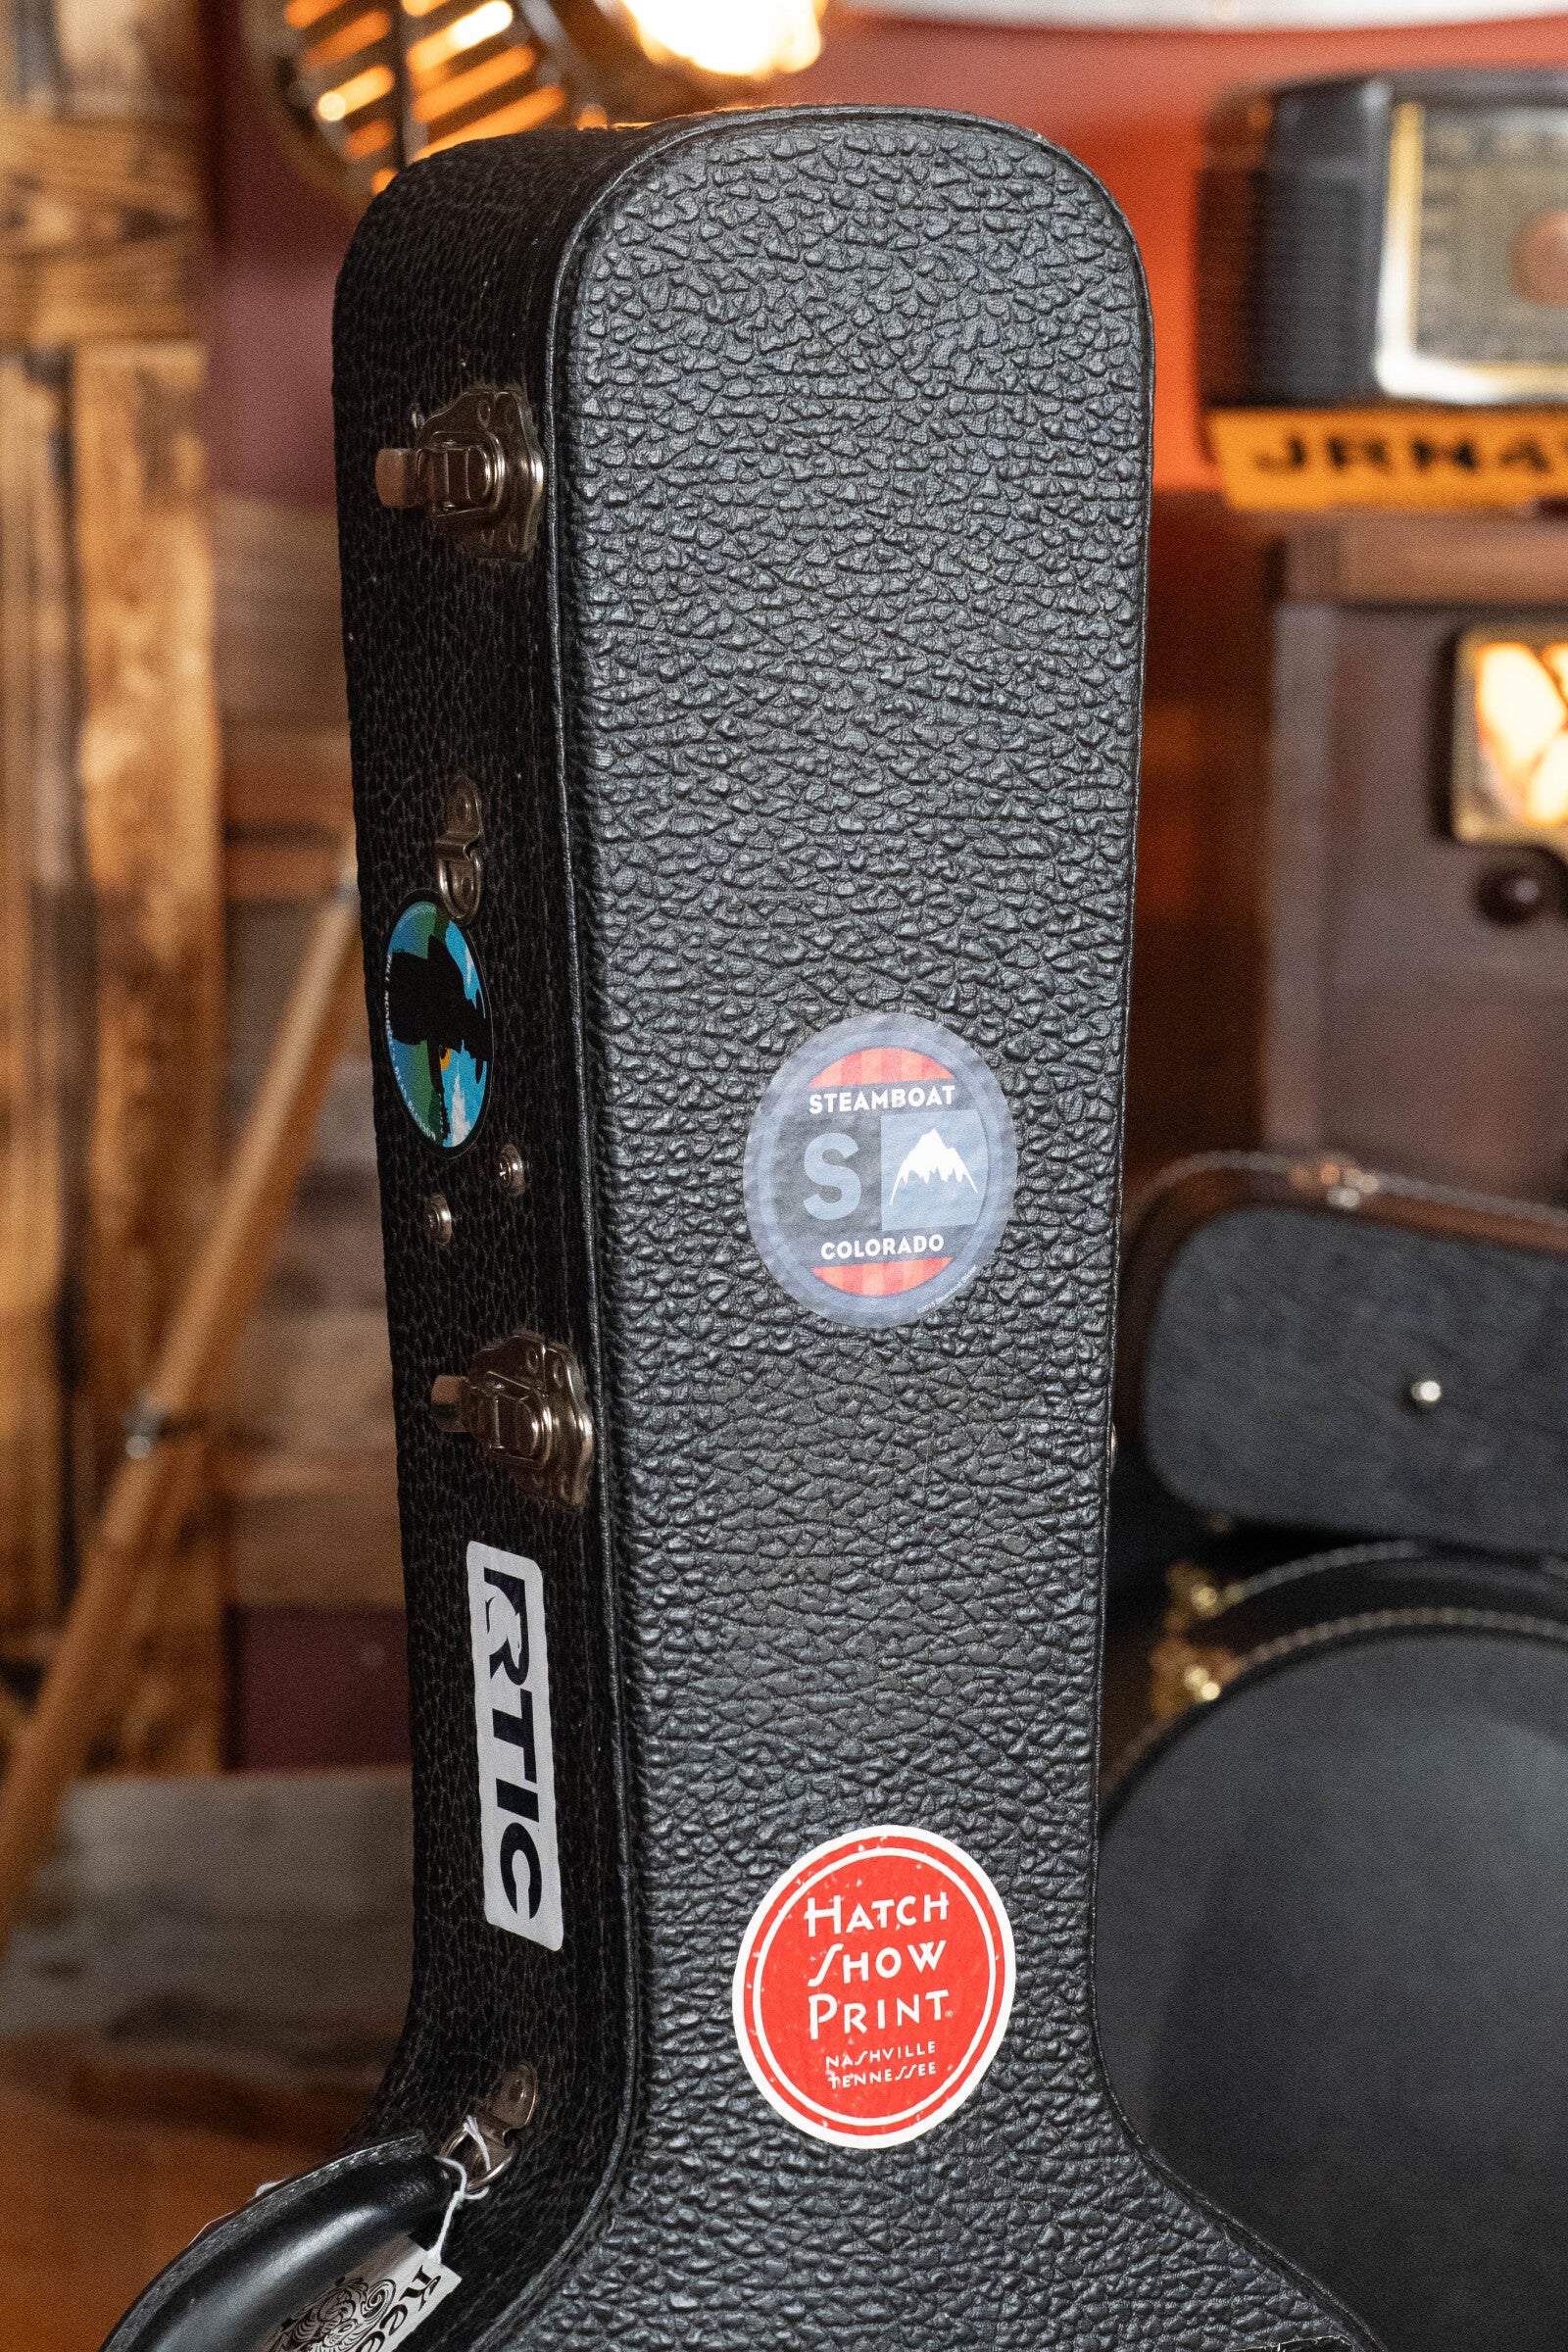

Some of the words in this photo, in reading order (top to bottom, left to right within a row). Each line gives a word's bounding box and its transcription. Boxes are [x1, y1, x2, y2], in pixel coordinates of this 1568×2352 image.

[808, 1085, 956, 1114] STEAMBOAT
[803, 1132, 861, 1220] S
[820, 1234, 945, 1260] COLORADO
[483, 1566, 543, 1921] RTIC
[804, 1891, 950, 1937] HATCH
[807, 1939, 947, 1987] SHOW
[825, 2040, 937, 2070] NASHVILLE
[827, 2061, 937, 2089] TENNESSEE
